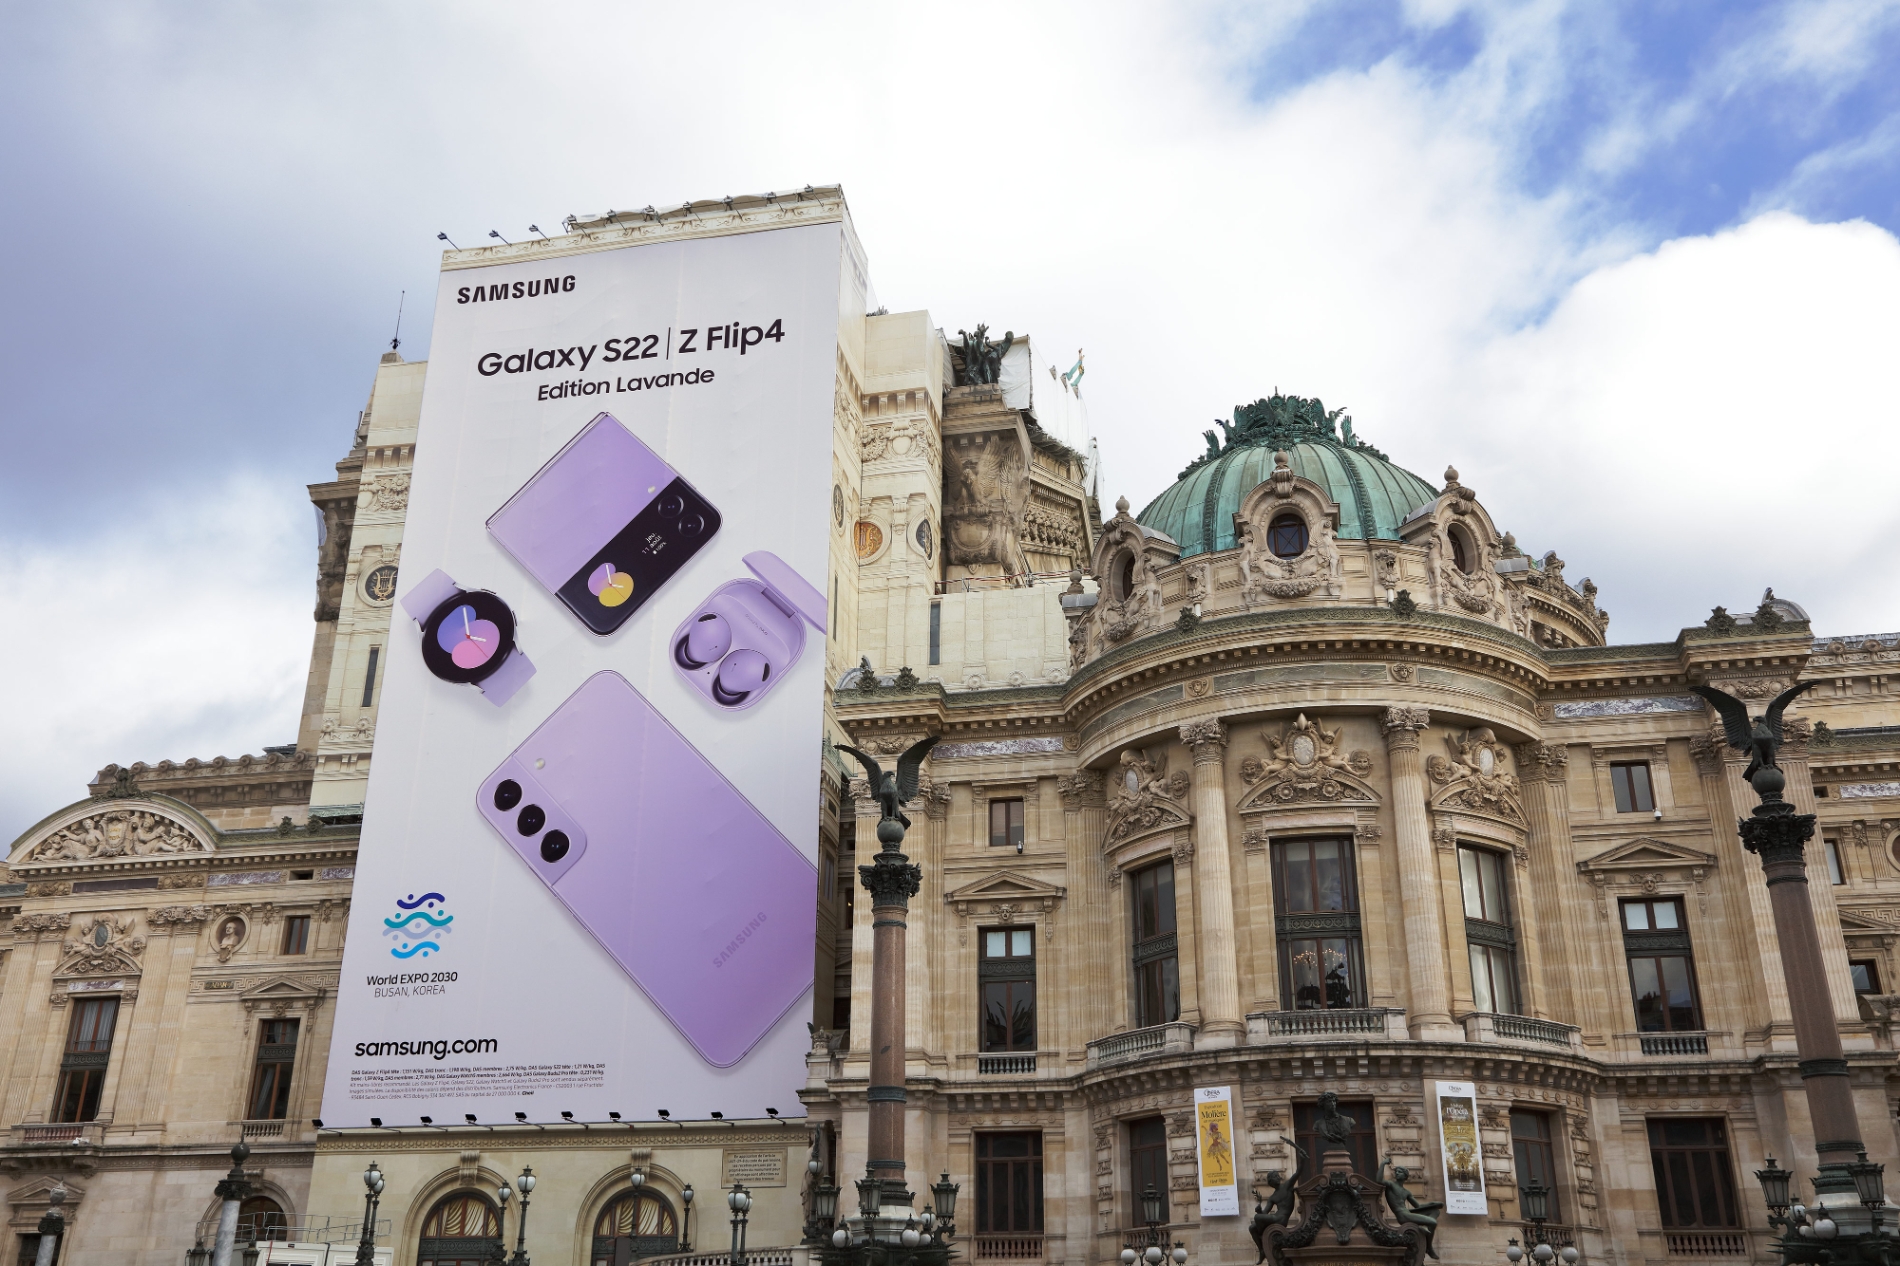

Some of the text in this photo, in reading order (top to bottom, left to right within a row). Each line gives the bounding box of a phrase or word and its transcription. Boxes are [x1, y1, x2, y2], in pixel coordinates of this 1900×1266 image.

[457, 275, 576, 304] SAMSUNG
[477, 319, 785, 376] Galaxy S22 Z Flip4
[537, 367, 715, 401] Edition Lavande
[713, 911, 767, 968] SAMSUNG
[367, 972, 458, 985] World EXPO 2030
[374, 985, 445, 998] BUSAN, KOREA
[355, 1039, 498, 1060] samsung.com
[1201, 1110, 1227, 1118] Molière
